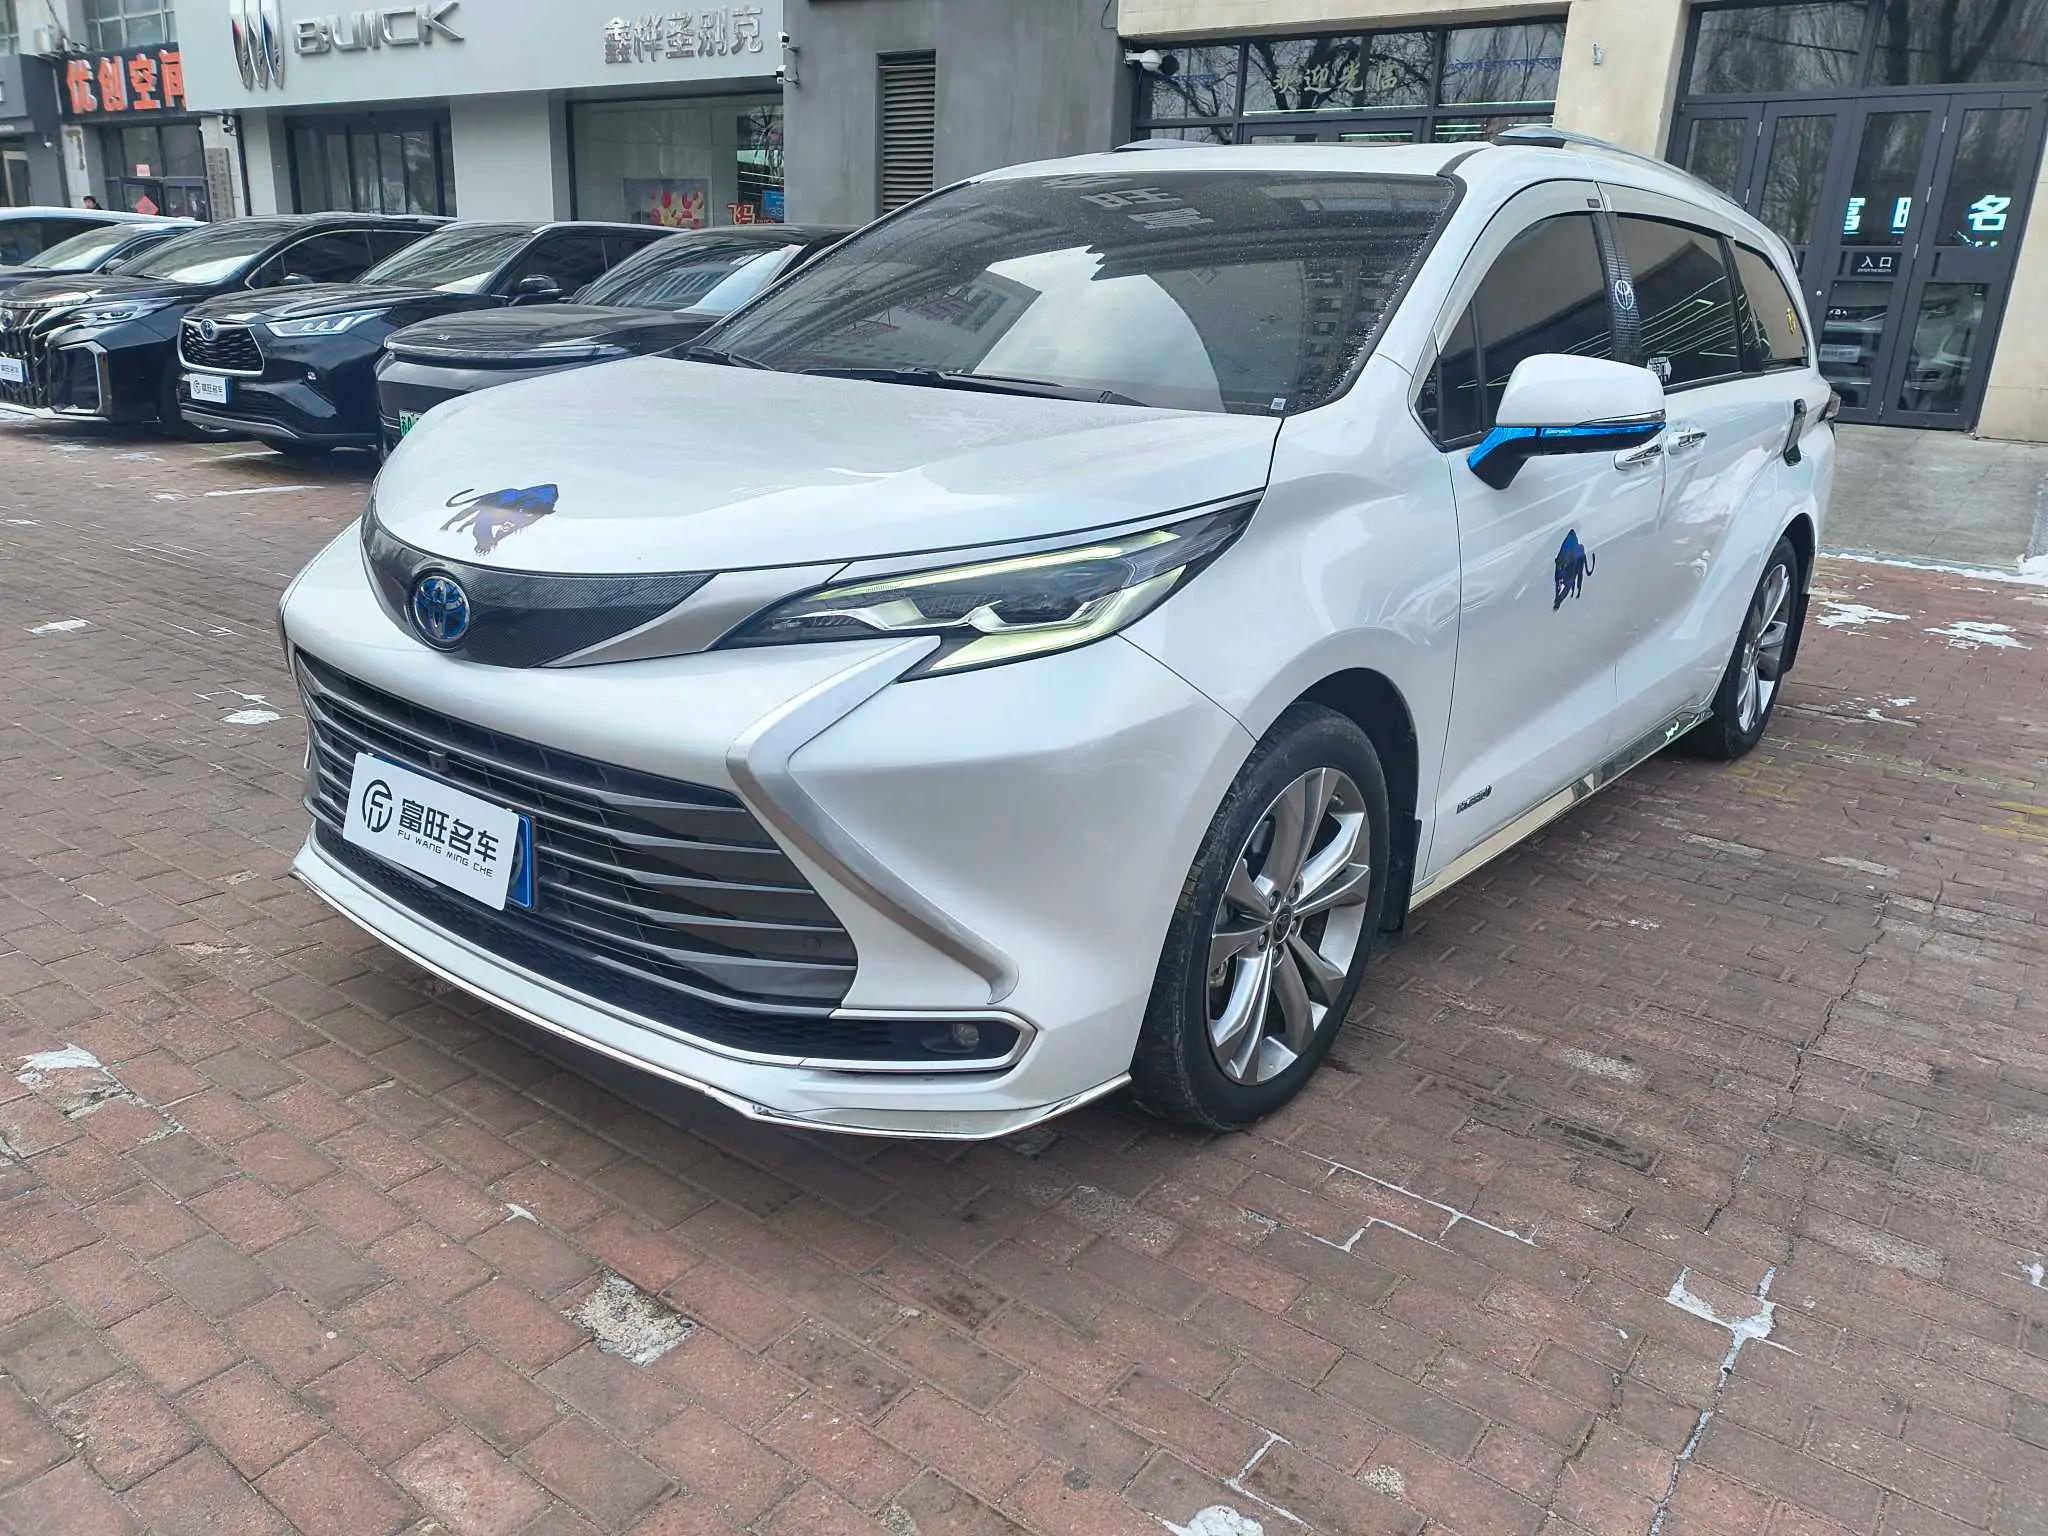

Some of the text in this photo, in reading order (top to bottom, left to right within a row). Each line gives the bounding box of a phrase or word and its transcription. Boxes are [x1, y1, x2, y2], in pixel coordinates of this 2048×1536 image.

[293, 0, 465, 55] BUICK
[1861, 255, 1893, 268] 入口
[397, 829, 494, 878] FU WANG MING CHE
[399, 798, 499, 863] 富旺名车
